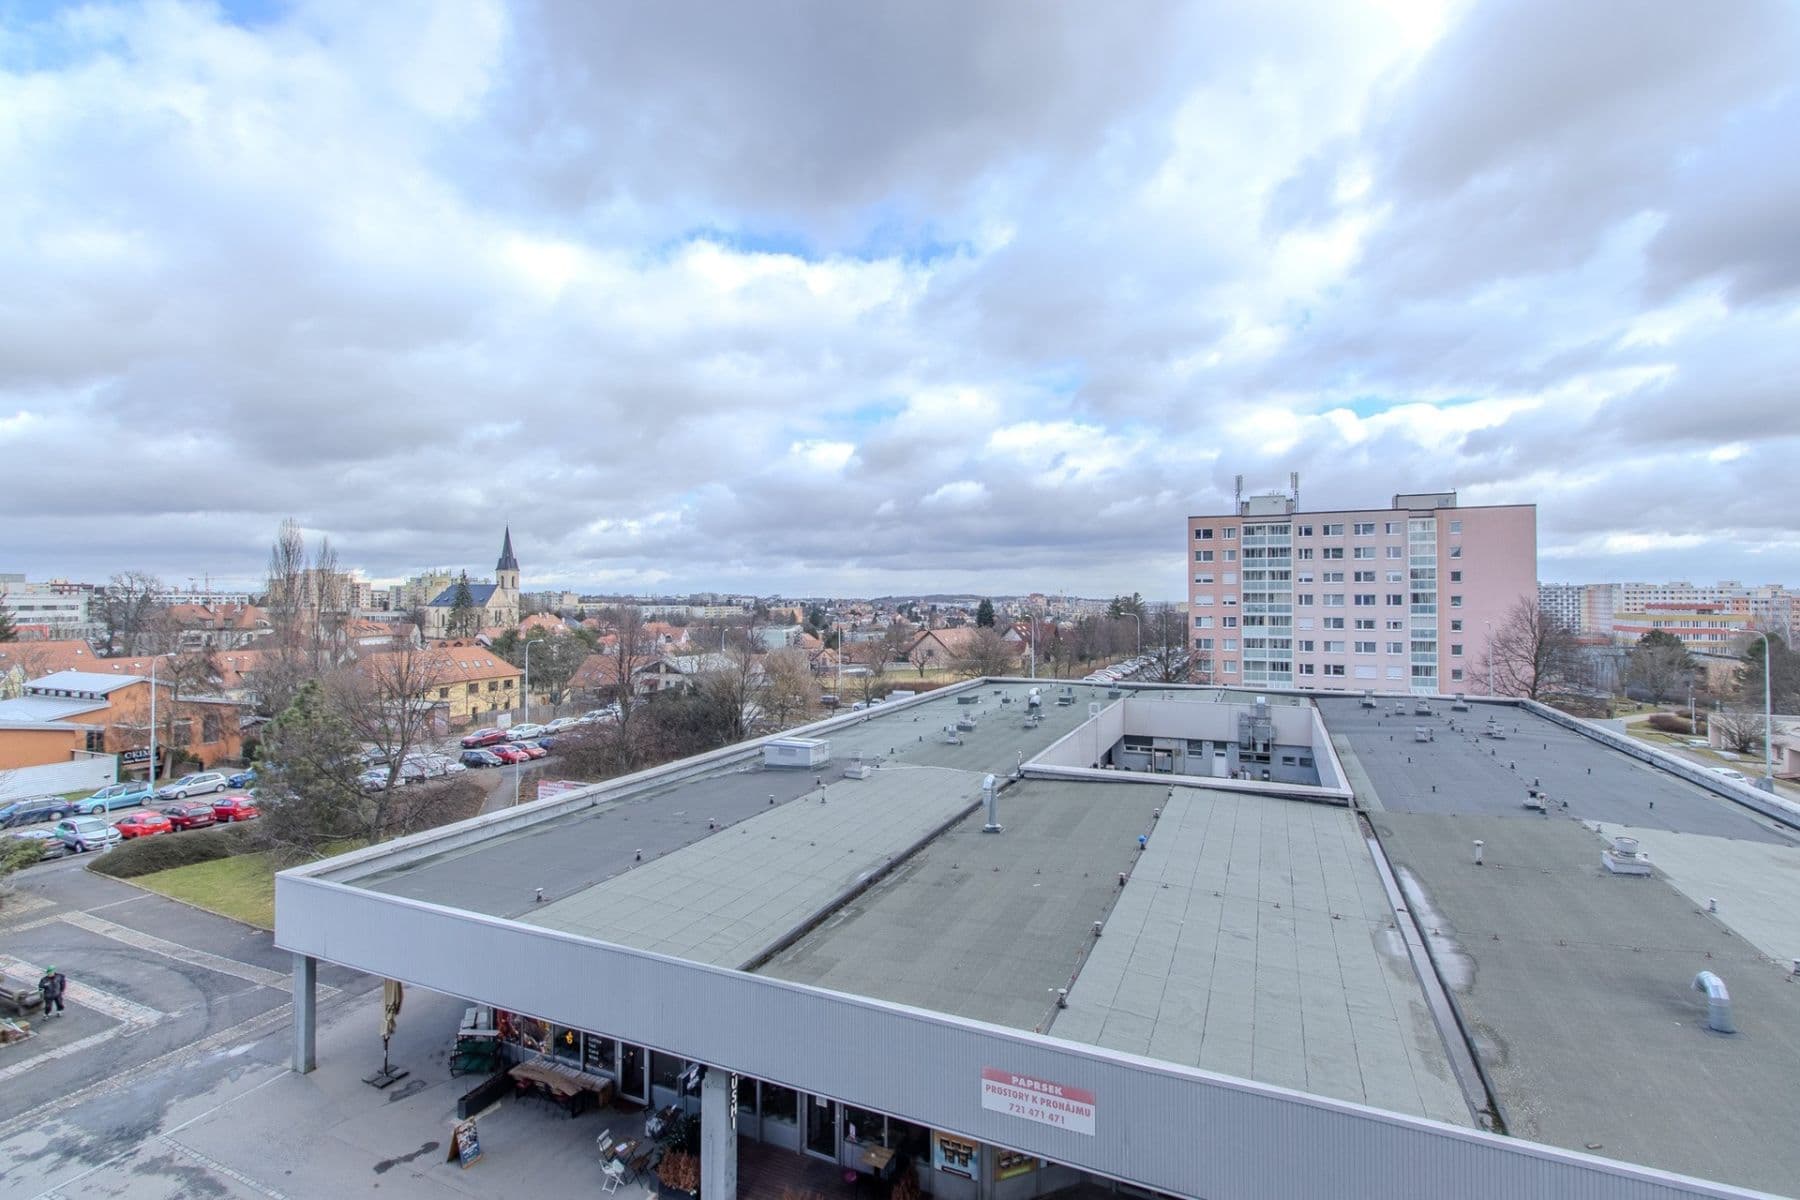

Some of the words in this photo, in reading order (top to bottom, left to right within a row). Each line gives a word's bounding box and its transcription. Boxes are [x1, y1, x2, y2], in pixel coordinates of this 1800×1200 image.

[985, 1083, 1030, 1104] PROSTORY
[1031, 1095, 1039, 1105] K
[1011, 1075, 1063, 1096] PAPRSEK
[730, 1072, 738, 1129] USHI
[1008, 1102, 1025, 1114] 721
[1028, 1109, 1045, 1120] 471
[1048, 1113, 1065, 1125] 471
